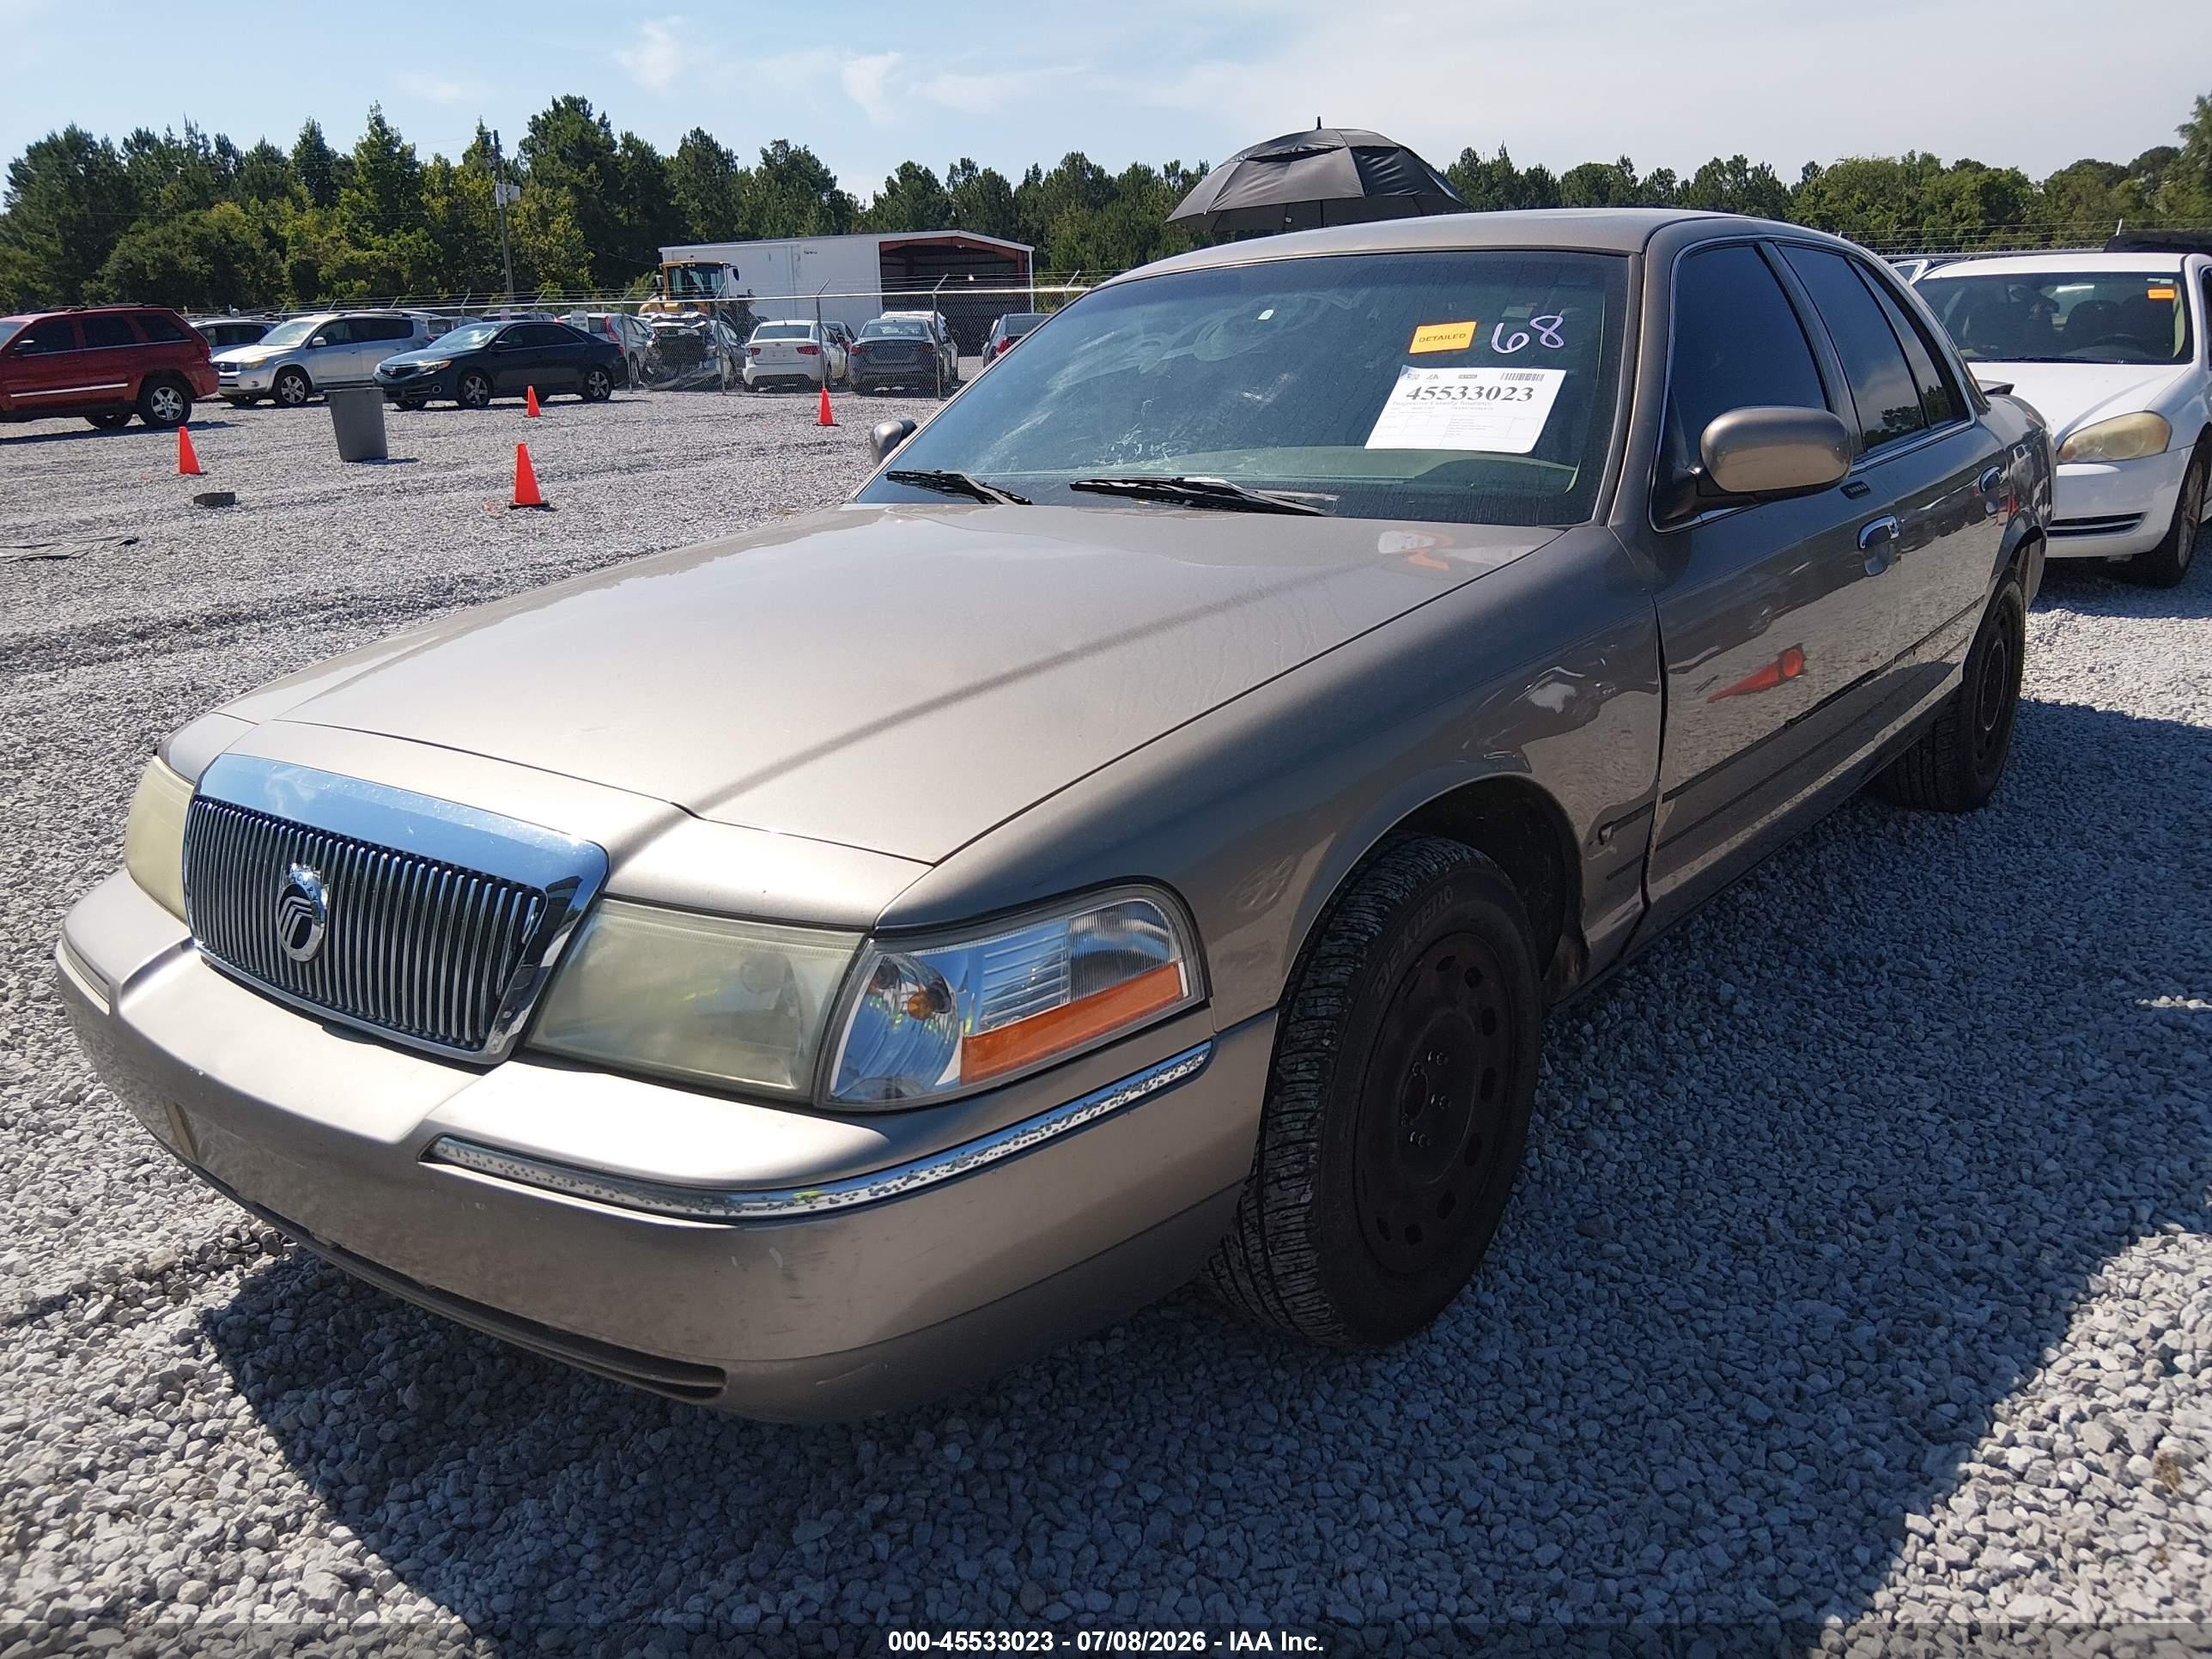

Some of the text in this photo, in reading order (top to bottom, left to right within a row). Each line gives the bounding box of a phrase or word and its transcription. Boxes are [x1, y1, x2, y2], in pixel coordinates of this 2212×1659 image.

[1419, 332, 1467, 343] DETAILED
[1491, 315, 1565, 354] 68
[1406, 386, 1534, 402] 45533023
